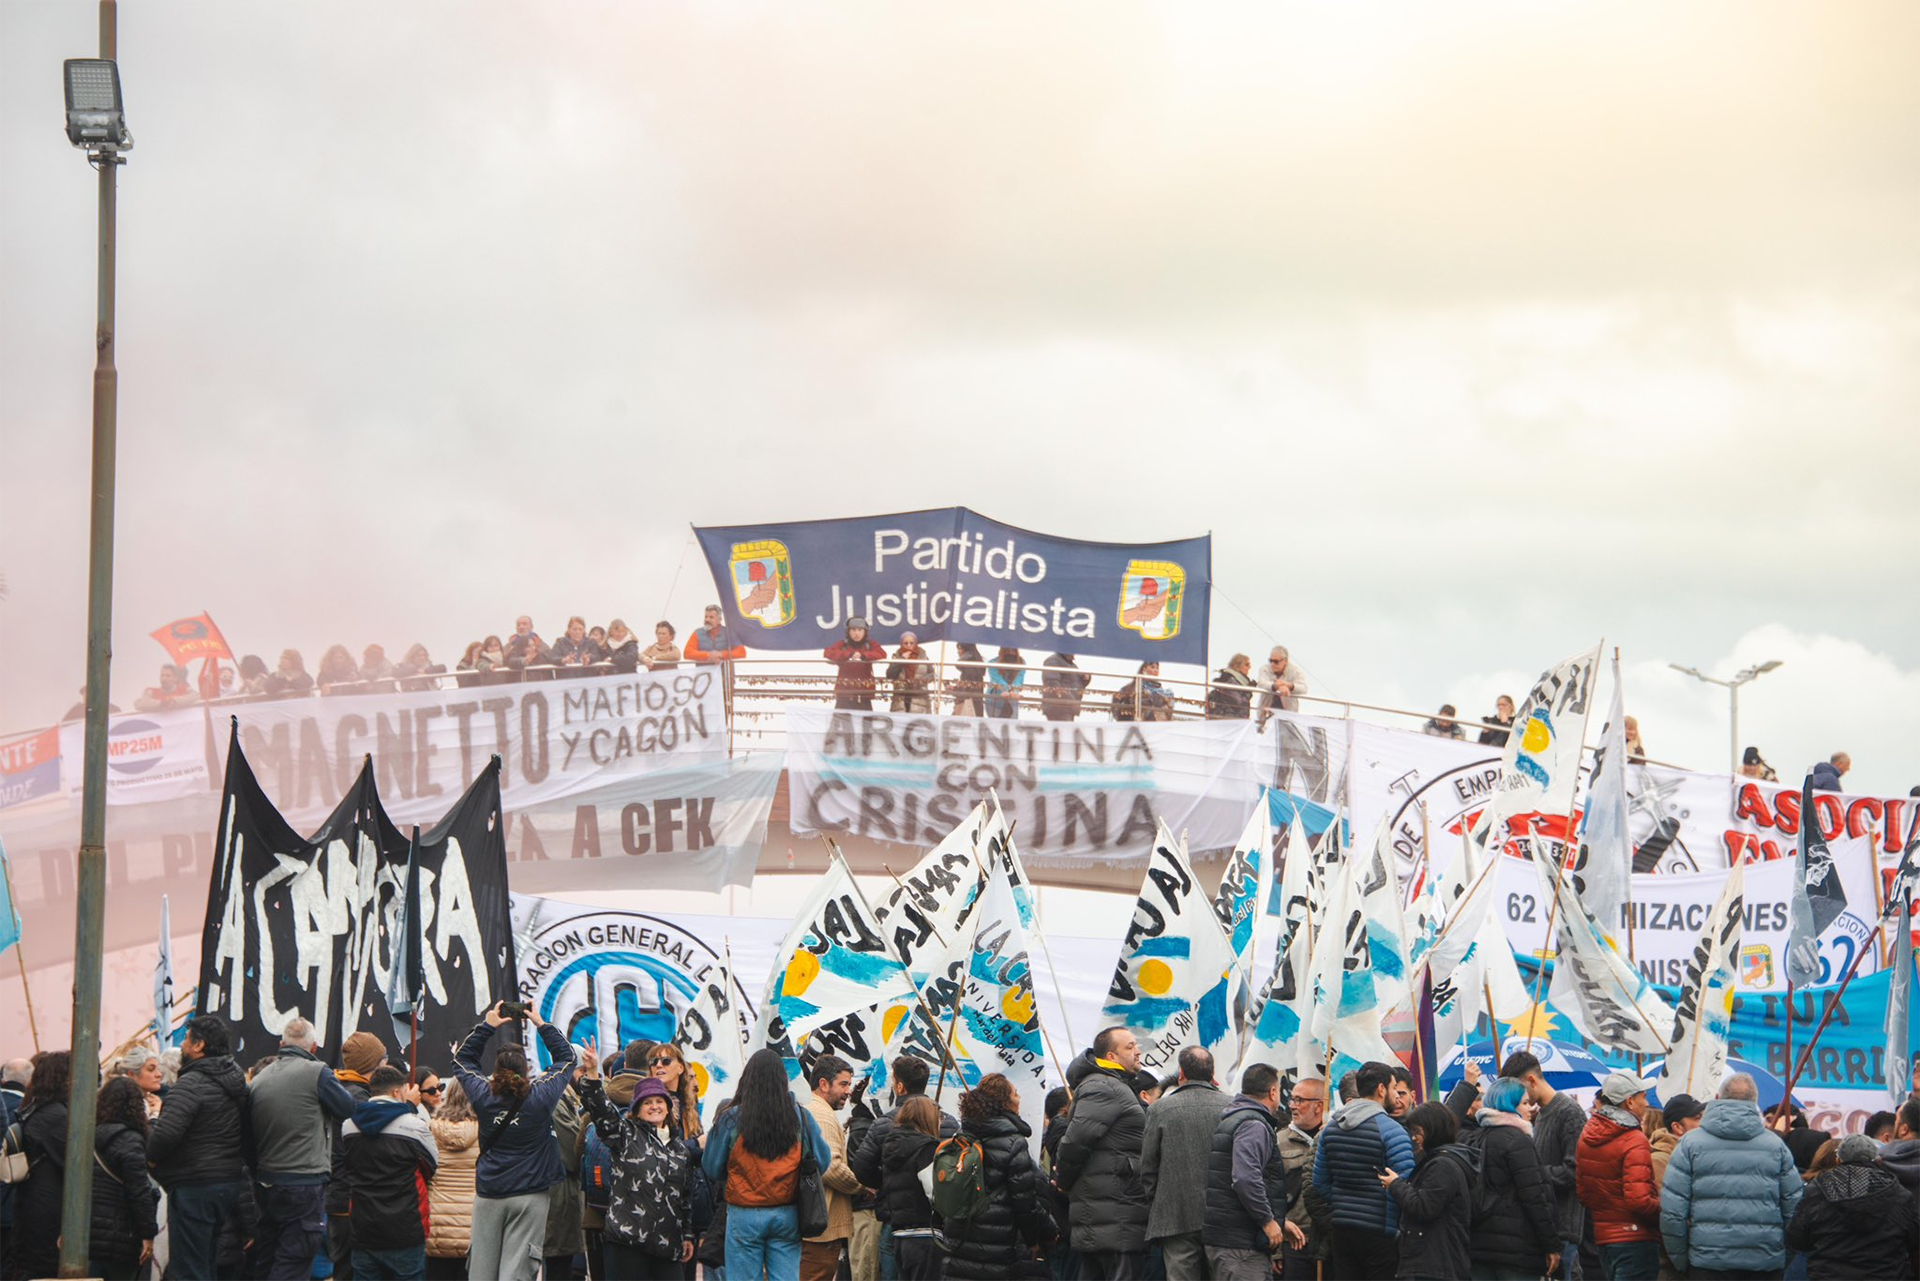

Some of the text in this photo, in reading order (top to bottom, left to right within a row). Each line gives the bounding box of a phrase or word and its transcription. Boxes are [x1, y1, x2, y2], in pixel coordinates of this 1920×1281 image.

[874, 529, 1047, 584] Partido
[815, 581, 1097, 639] Justicialista
[563, 672, 712, 725] MAFIOSO
[243, 690, 550, 812] MAGNETTO
[560, 731, 582, 772] Y
[822, 711, 1155, 763] ARGENTINA
[936, 764, 1038, 793] CON
[572, 805, 602, 858] A
[621, 797, 716, 856] CFK
[1506, 892, 1537, 924] 62
[588, 924, 700, 970] GENERAL
